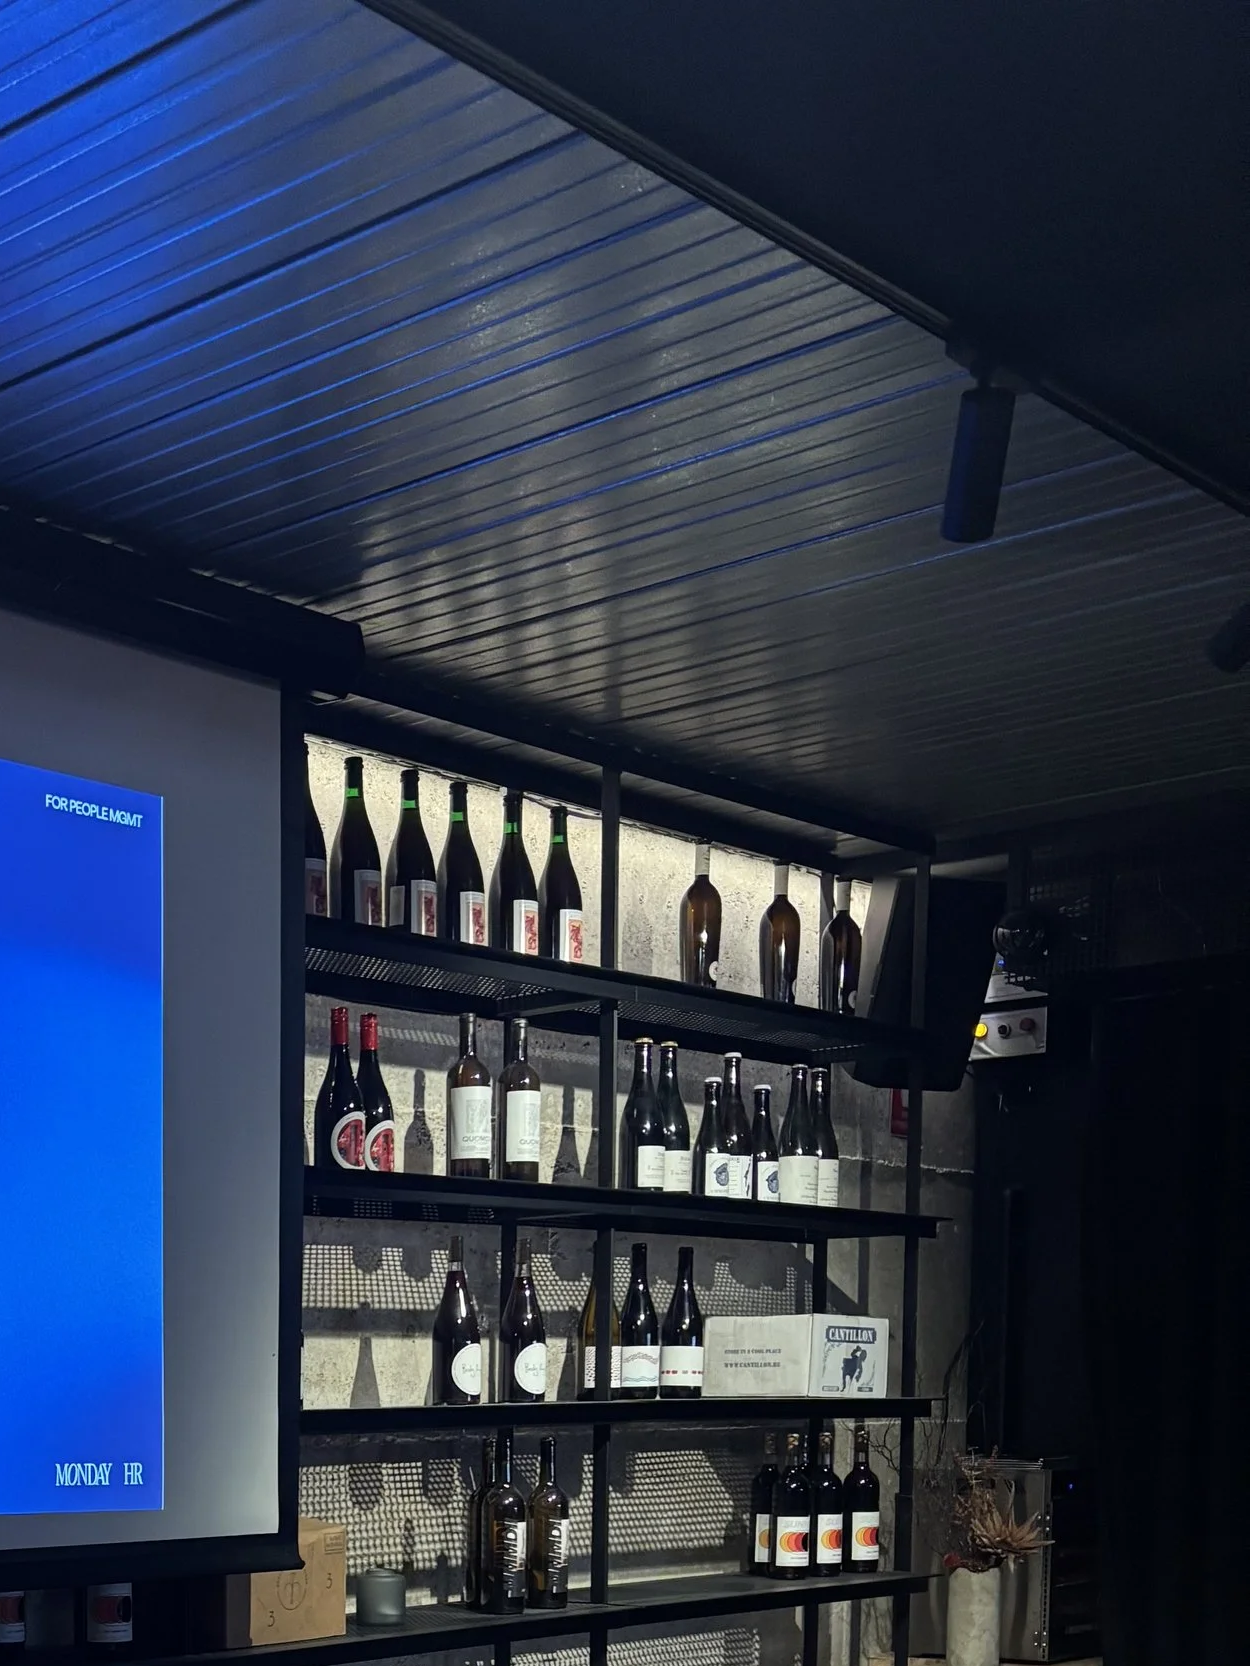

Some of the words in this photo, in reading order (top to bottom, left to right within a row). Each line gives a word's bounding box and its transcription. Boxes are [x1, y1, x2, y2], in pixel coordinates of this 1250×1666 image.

[45, 794, 69, 811] FOR
[69, 799, 109, 821] PEOPLE
[110, 808, 143, 828] MGMT
[829, 1328, 874, 1342] CANTILLON
[55, 1463, 112, 1486] MONDAY
[123, 1462, 144, 1485] HR
[326, 1572, 333, 1590] 3
[267, 1610, 276, 1628] 3
